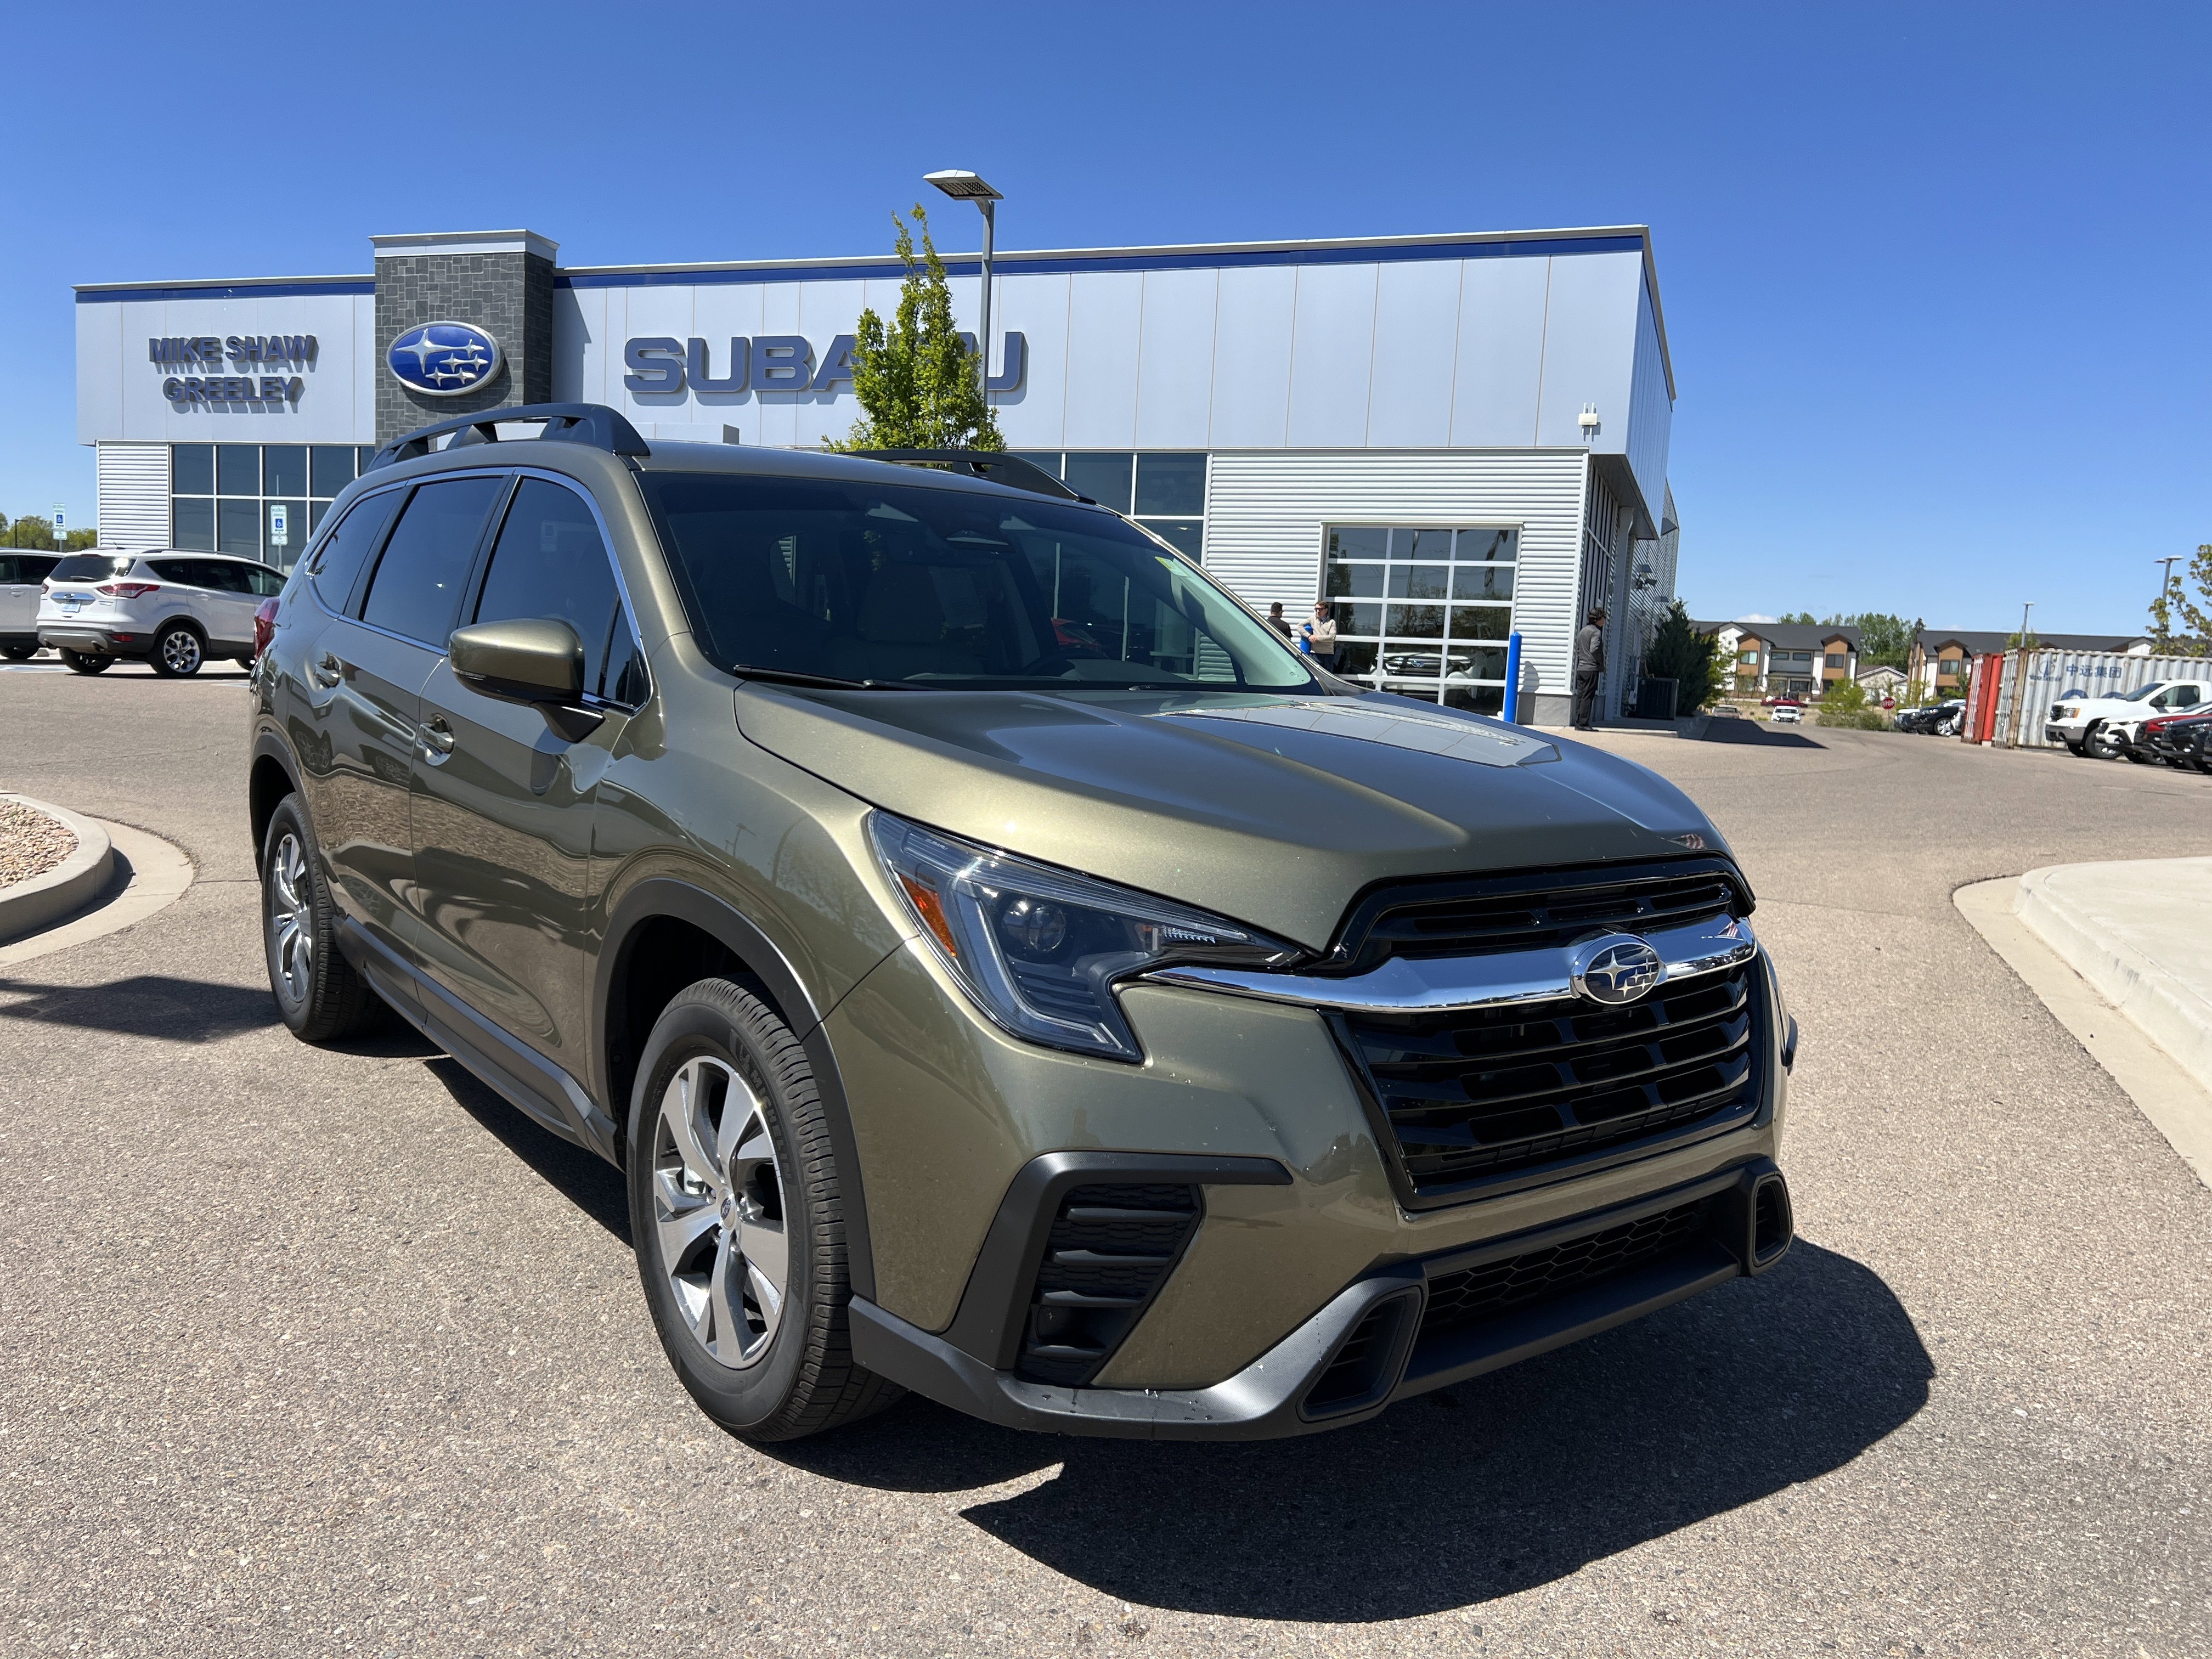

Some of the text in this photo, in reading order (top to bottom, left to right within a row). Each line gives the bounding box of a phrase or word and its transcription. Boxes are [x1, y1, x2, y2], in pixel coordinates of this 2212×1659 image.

[149, 335, 317, 362] MIKE SHAW
[624, 331, 1024, 393] SUBAU
[162, 376, 303, 402] GREELEY
[749, 1069, 791, 1178] MICHELIN
